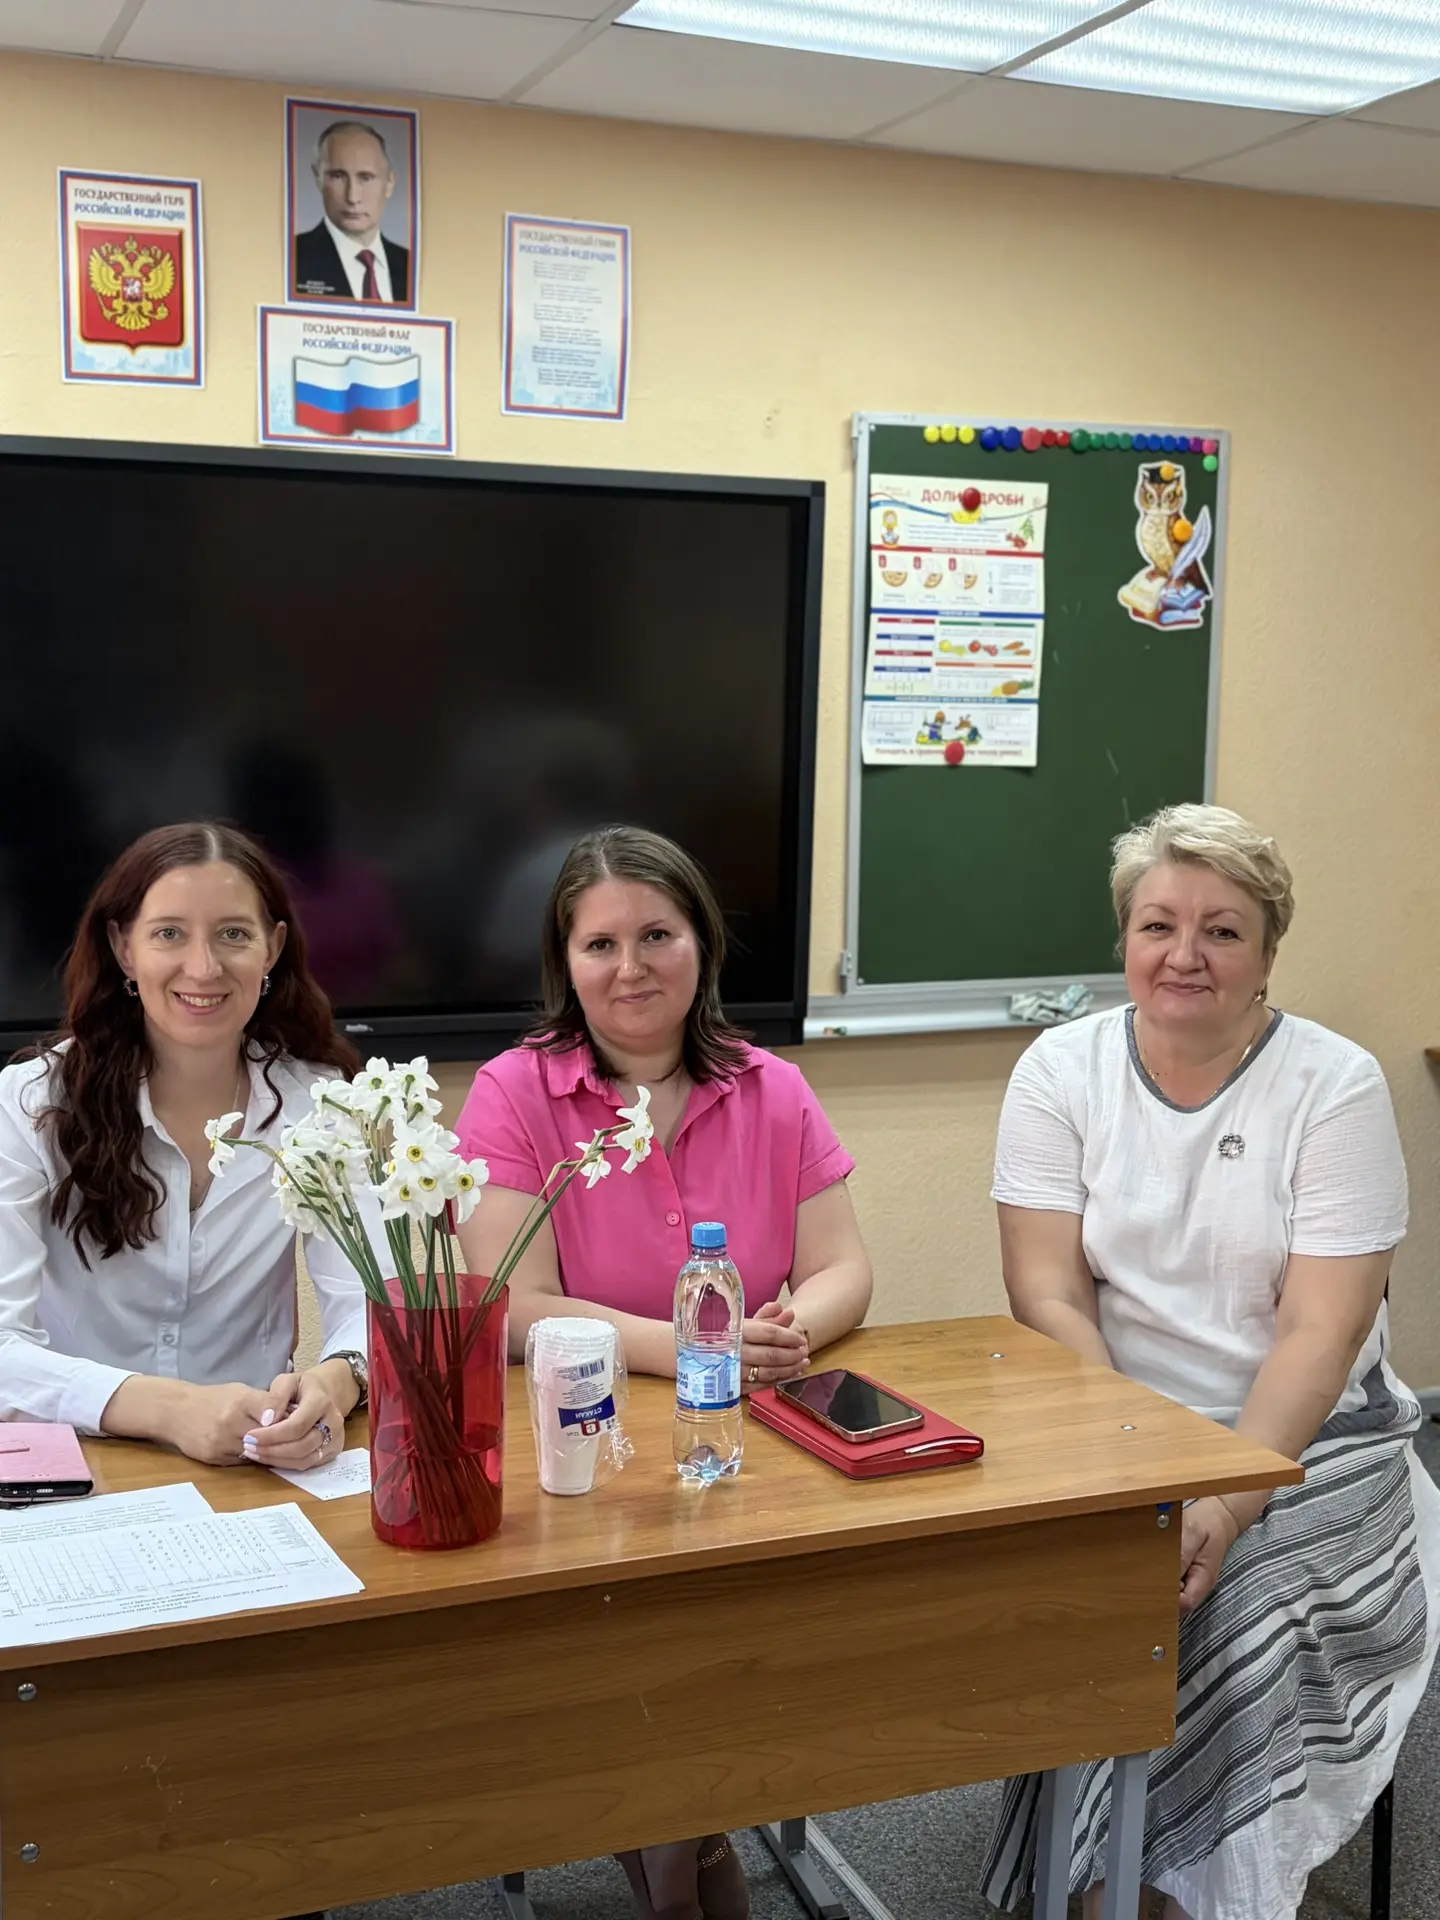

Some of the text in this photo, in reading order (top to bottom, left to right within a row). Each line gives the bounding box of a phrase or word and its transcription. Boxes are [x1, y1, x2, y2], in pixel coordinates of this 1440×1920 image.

[74, 188, 185, 206] ГОСУДАРСТВЕННЫЙ ГЕРБ
[74, 202, 185, 221] РОССИЙСКОЙ ФЕДЕРАЦИИ
[303, 322, 410, 340] ГОСУДАРСТВЕННЫЙ ФЛАГ
[303, 337, 411, 355] РОССИЙСКОЙ ФЕДЕРАЦИИ
[921, 488, 962, 503] ДОЛИ
[979, 491, 1024, 507] ДРОБИ
[575, 1406, 603, 1419] СТАКАН
